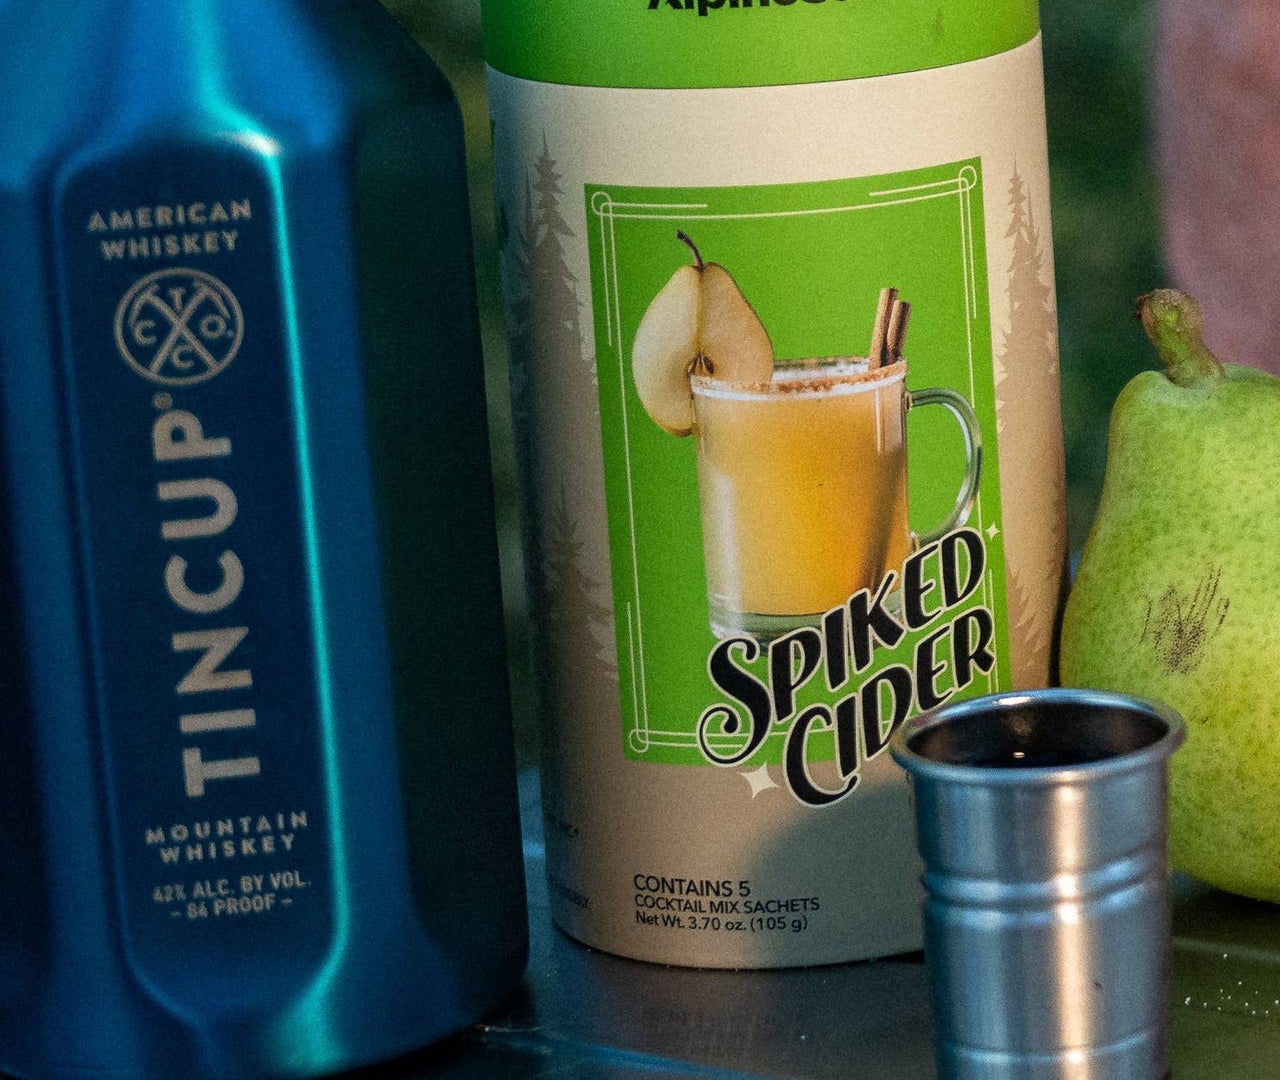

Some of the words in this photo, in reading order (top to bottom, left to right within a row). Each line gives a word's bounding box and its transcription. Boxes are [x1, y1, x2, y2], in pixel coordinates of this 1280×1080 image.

[87, 199, 252, 232] AMERICAN
[101, 229, 238, 261] WHISKEY
[153, 409, 261, 797] TINCUP
[698, 526, 986, 768] SPIKED
[783, 605, 996, 808] CIDER
[145, 811, 308, 845] MOUNTAIN
[160, 832, 294, 863] WHISKEY
[193, 879, 235, 899] ALC.
[240, 874, 264, 894] BY
[270, 870, 312, 891] VOL.
[633, 873, 733, 897] CONTAINS
[739, 880, 750, 897] 5
[214, 893, 276, 916] PROOF
[635, 894, 706, 913] COCKTAIL
[709, 901, 740, 914] MIX
[744, 897, 820, 914] SACHETS
[635, 910, 659, 926] Net
[662, 914, 685, 929] Wt.
[688, 916, 721, 930] 3.70
[725, 921, 747, 931] oz.
[751, 916, 787, 932] (105
[791, 916, 808, 932] g)
